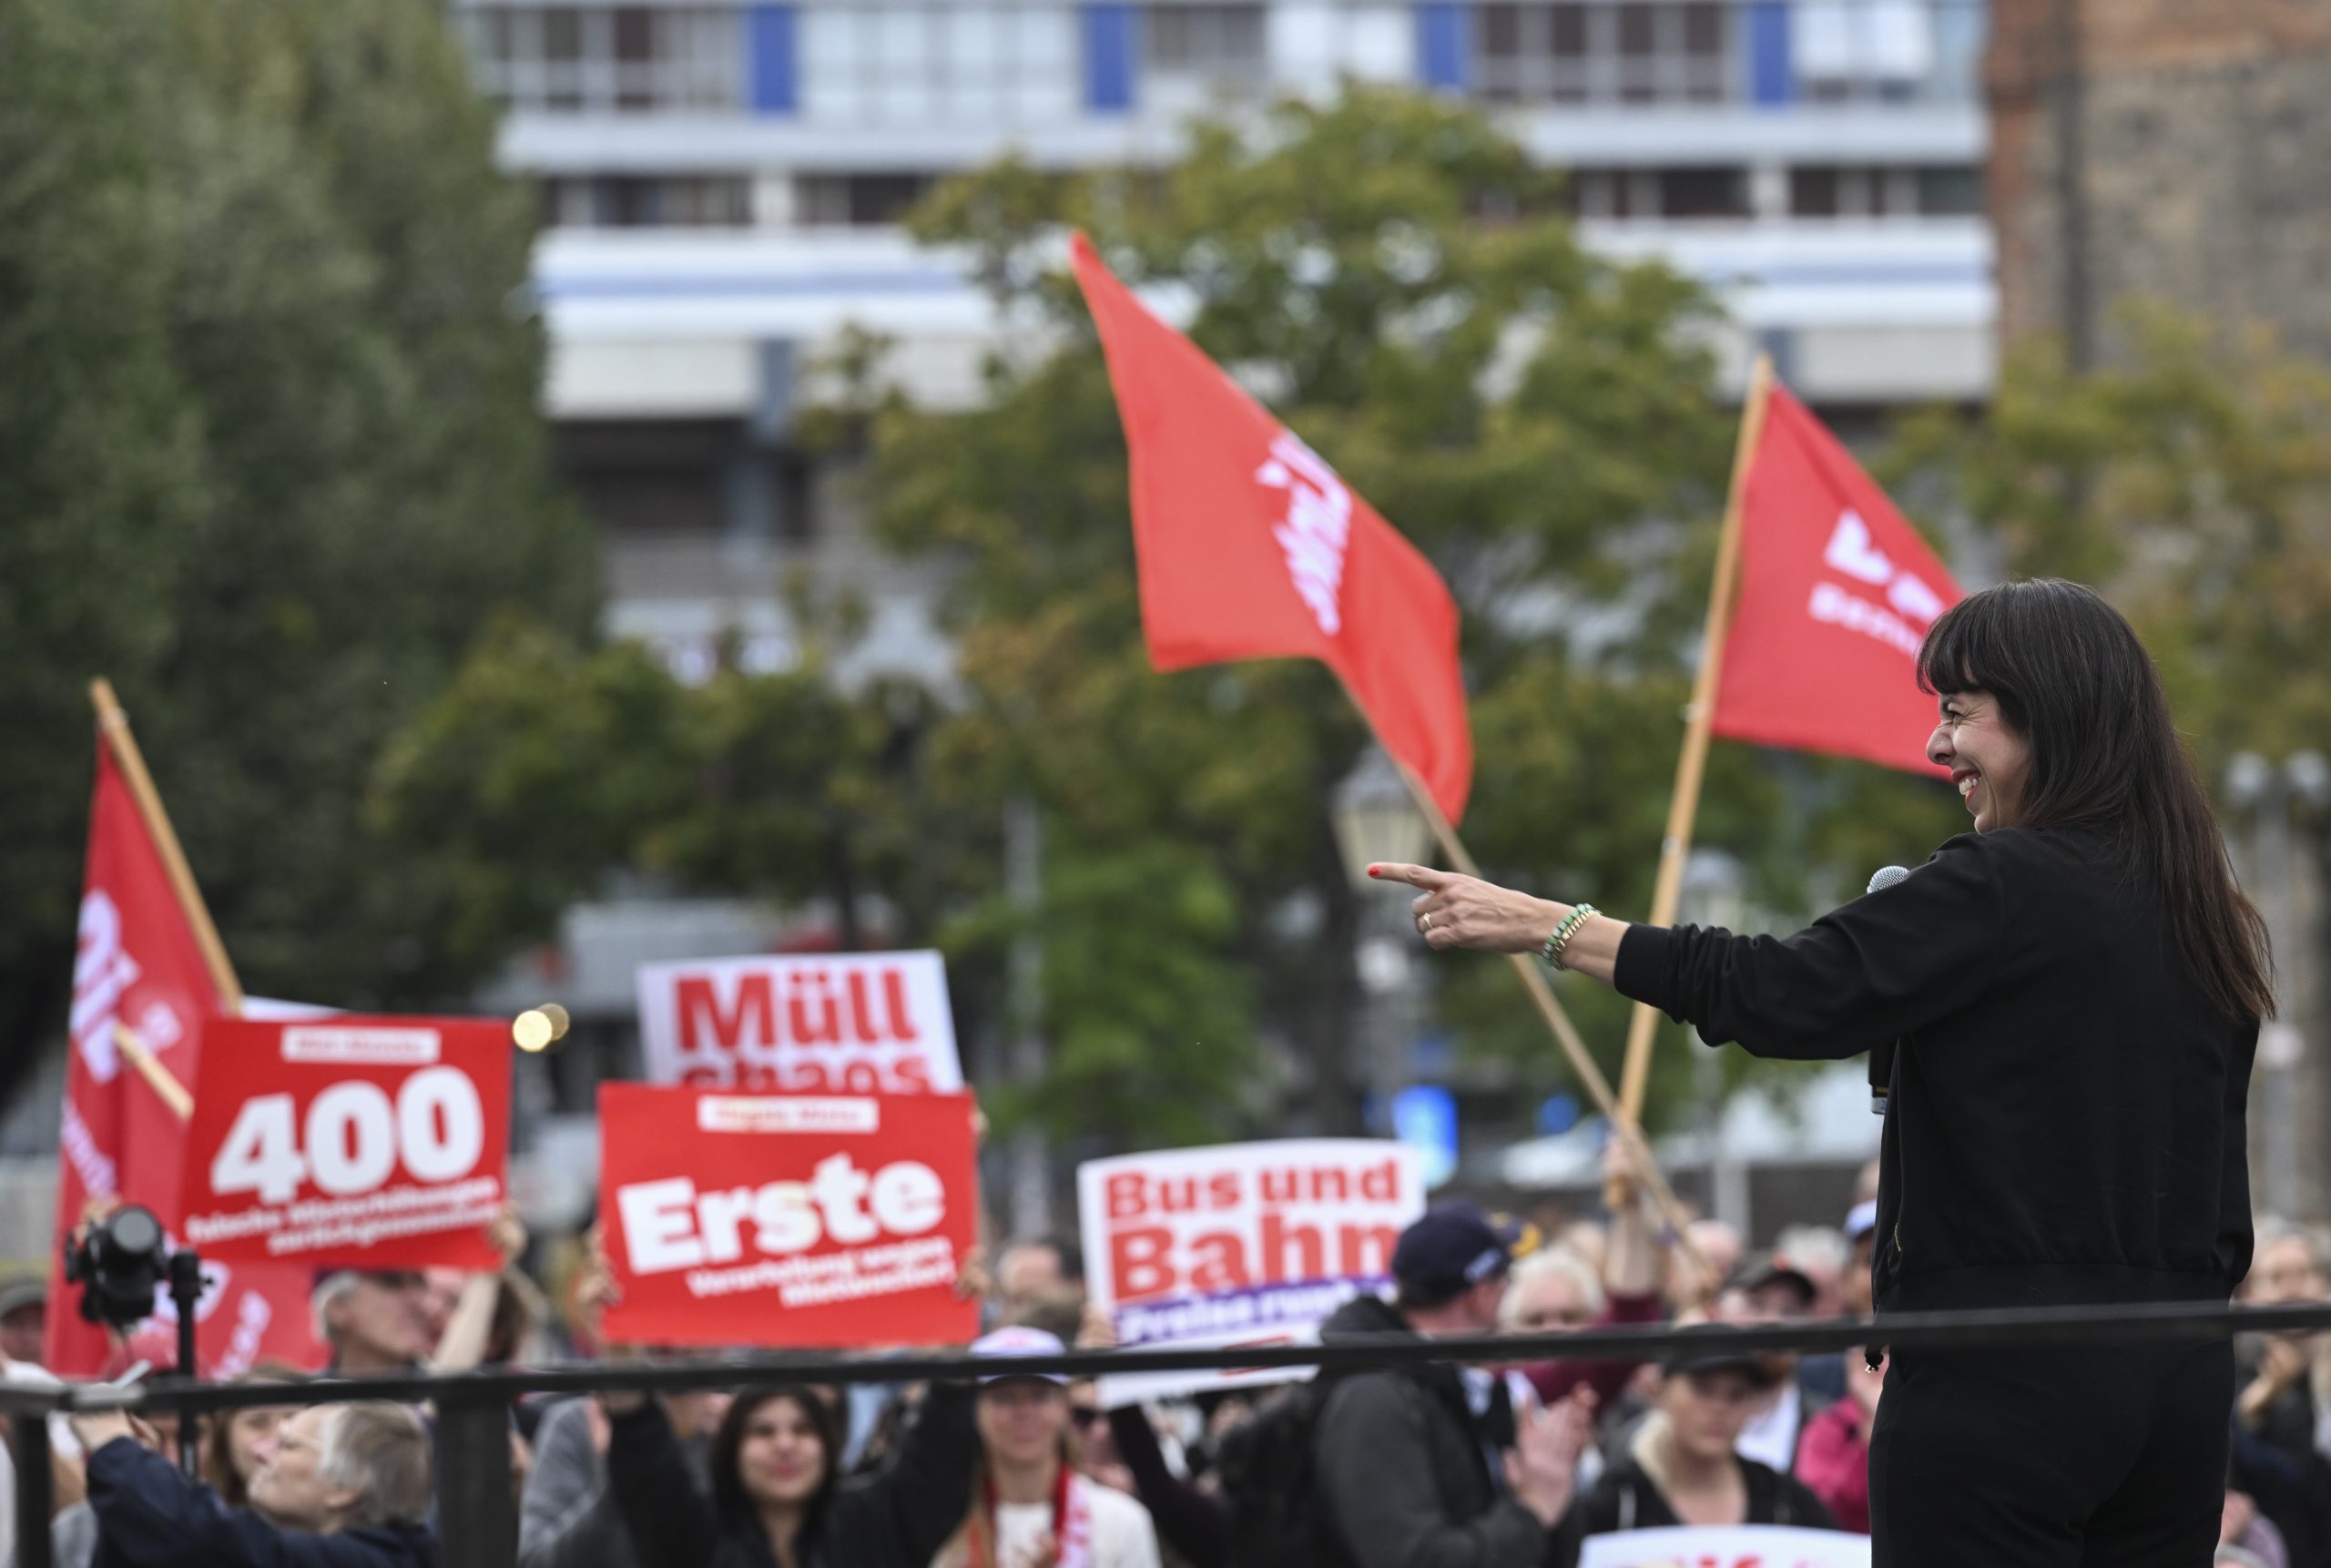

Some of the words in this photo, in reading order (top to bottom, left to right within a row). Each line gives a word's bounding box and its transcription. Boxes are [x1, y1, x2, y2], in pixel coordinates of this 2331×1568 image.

[677, 970, 919, 1054] Müll
[212, 1066, 484, 1204] 400
[618, 1153, 945, 1274] Erste
[1106, 1171, 1242, 1218] Bus
[1259, 1159, 1399, 1204] und
[1111, 1213, 1399, 1302] Bahn
